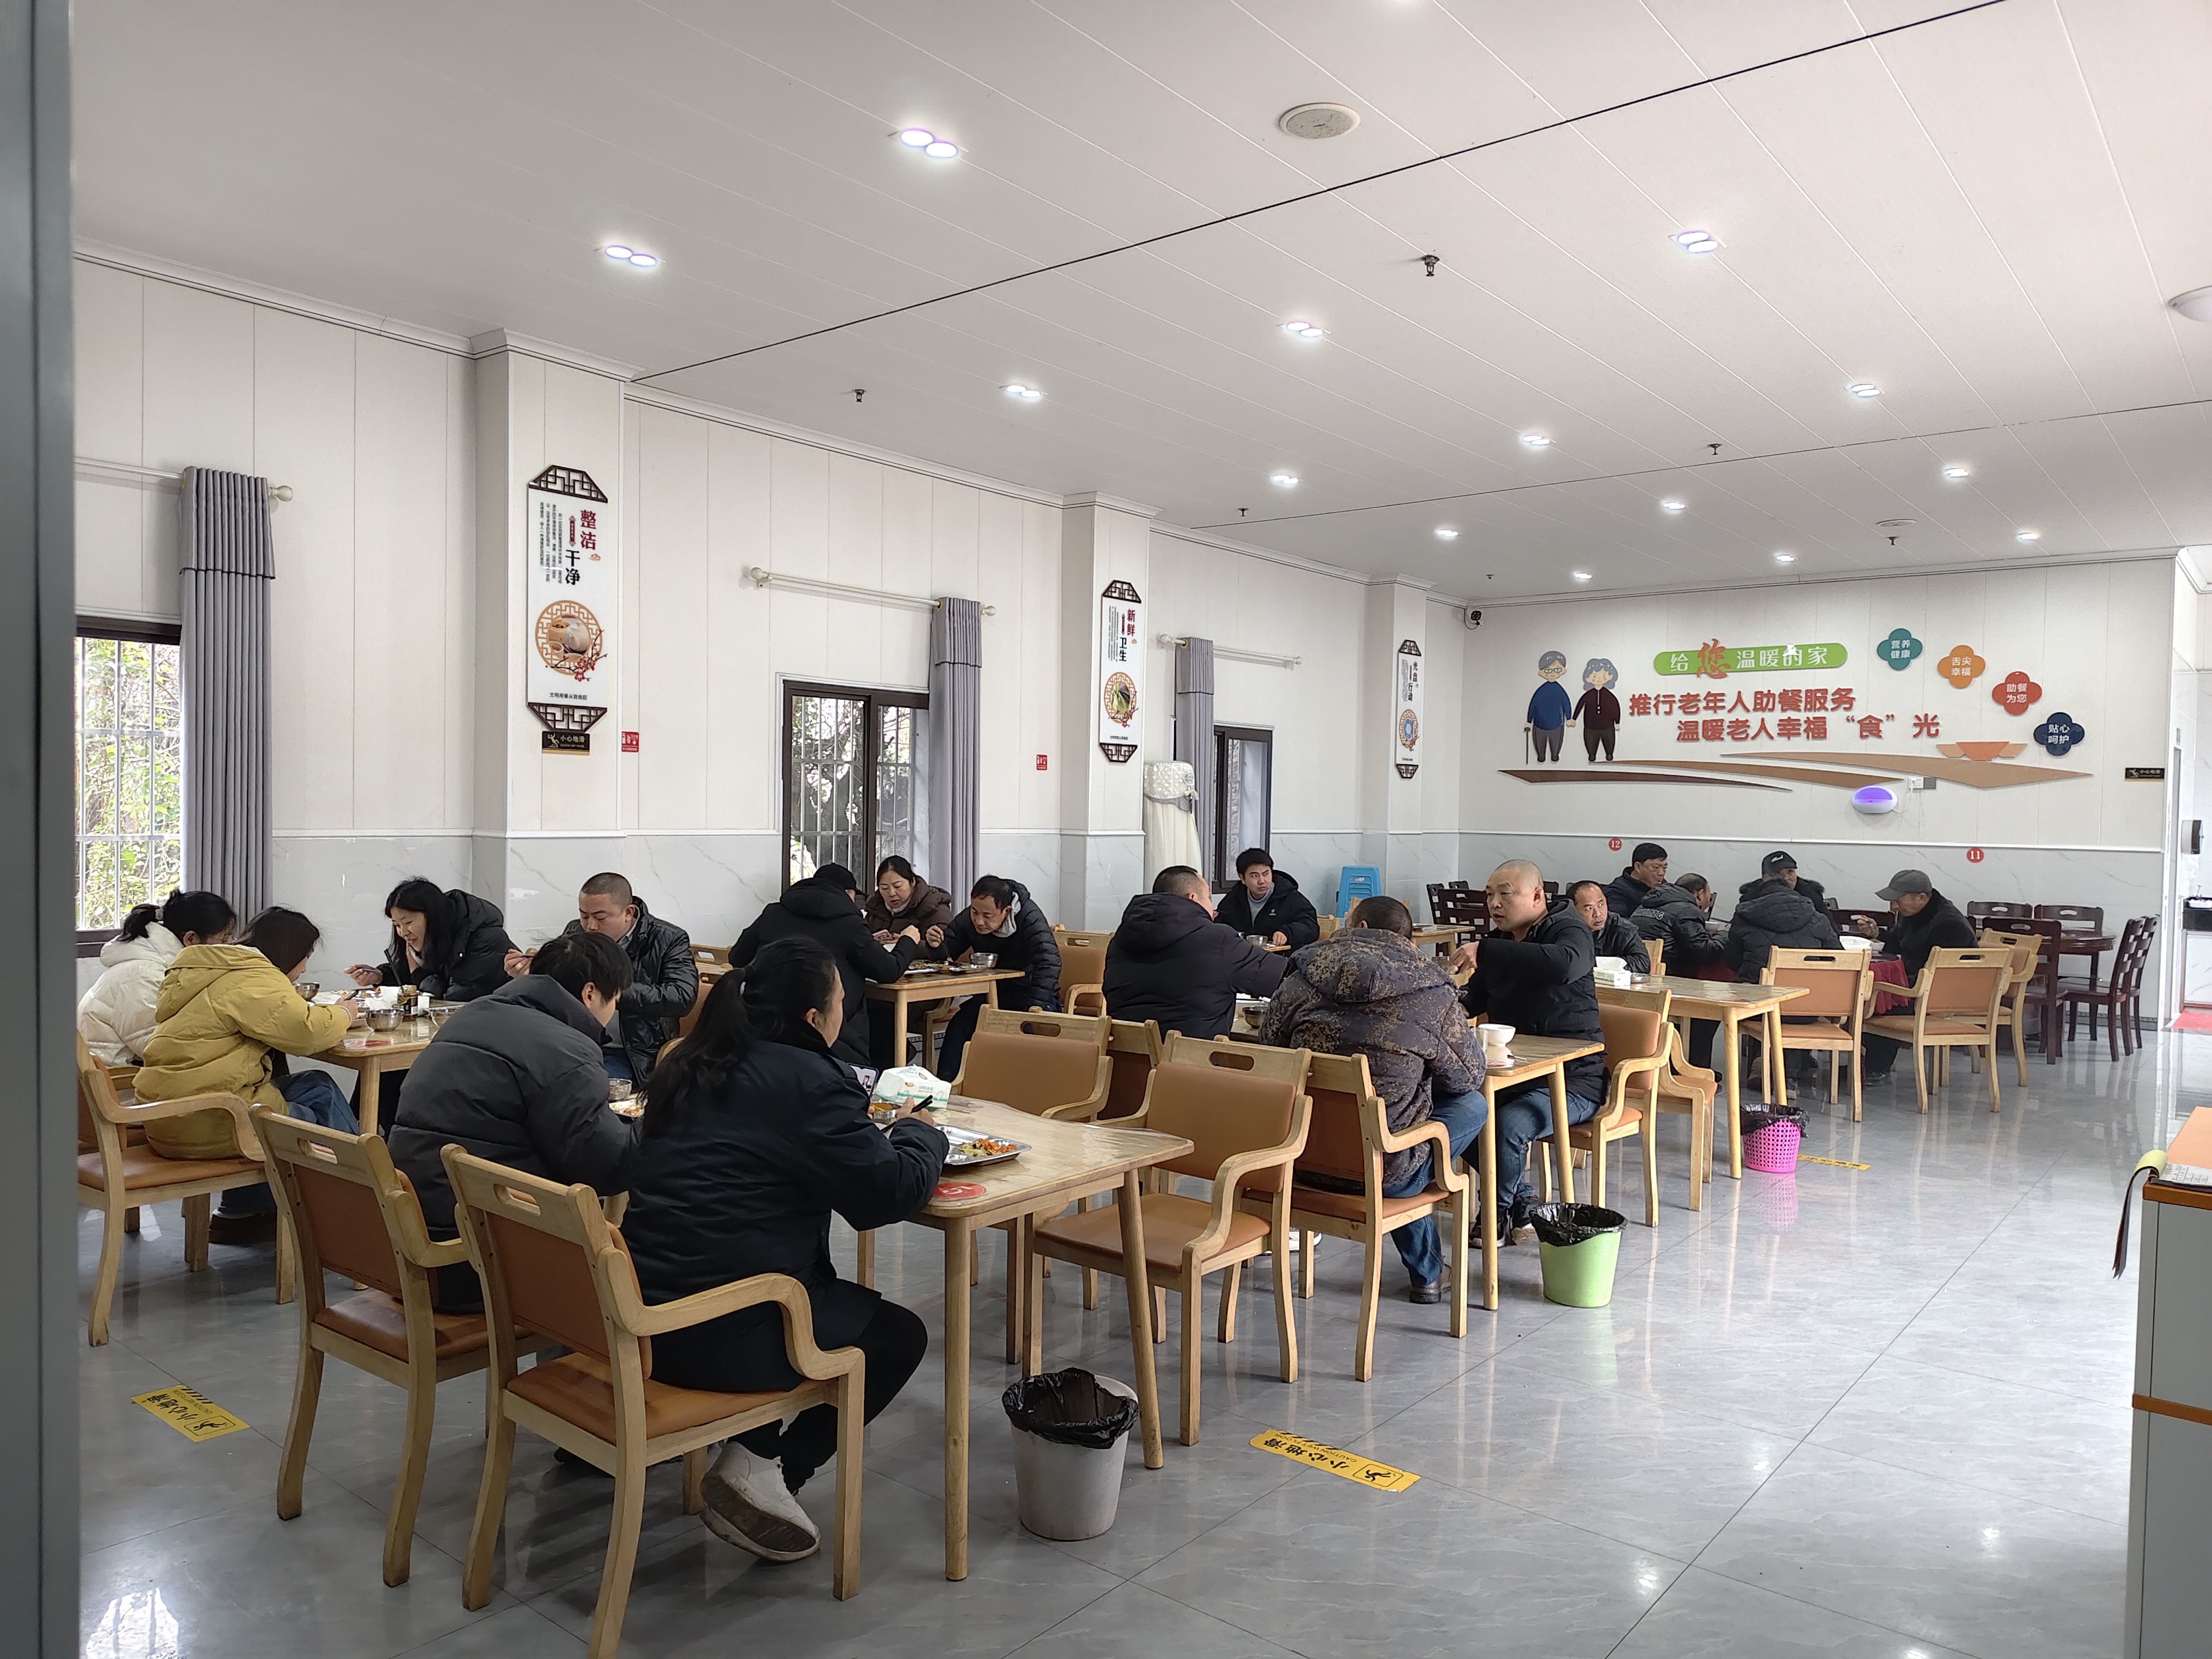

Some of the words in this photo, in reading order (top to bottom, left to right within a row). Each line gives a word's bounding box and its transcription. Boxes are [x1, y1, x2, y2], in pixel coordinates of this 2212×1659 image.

[580, 509, 597, 550] 整洁
[565, 549, 581, 585] 干净
[1127, 609, 1136, 637] 新鲜
[1890, 639, 1911, 649] 营养
[1119, 637, 1127, 662] 卫生
[1890, 649, 1911, 659] 健康
[1951, 657, 1972, 666] 舌尖
[1951, 667, 1971, 677] 幸福
[2006, 683, 2028, 692] 助餐
[1629, 687, 1856, 716] 推行老年人助餐服务
[2006, 693, 2027, 703] 为您
[2048, 724, 2070, 733] 贴心
[560, 734, 585, 743] 小心地滑
[2048, 734, 2070, 745] 呵护
[1611, 840, 1621, 848] 12
[1970, 851, 1981, 860] 11
[942, 1185, 973, 1195] 5
[141, 1393, 198, 1420] 小心地滑
[1274, 1433, 1301, 1445] FLOOR
[1263, 1438, 1350, 1469] 小心地滑
[1320, 1448, 1357, 1463] CAUTION
